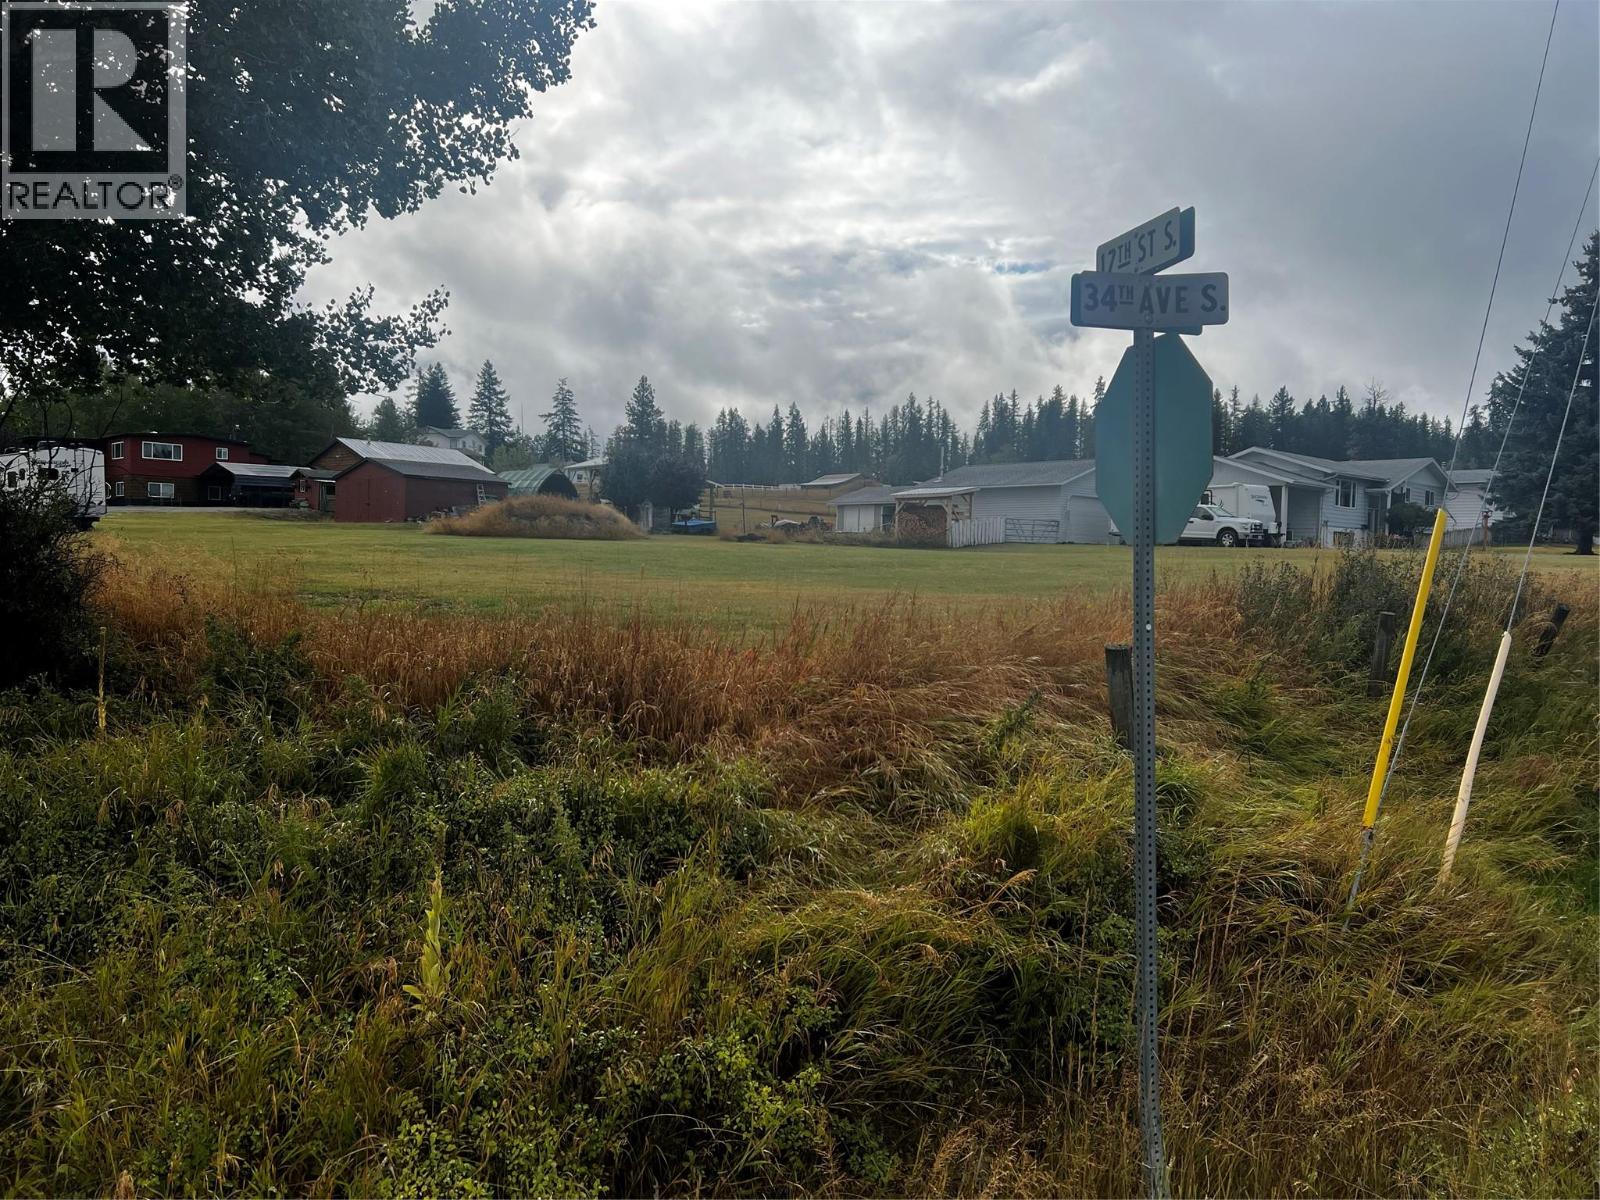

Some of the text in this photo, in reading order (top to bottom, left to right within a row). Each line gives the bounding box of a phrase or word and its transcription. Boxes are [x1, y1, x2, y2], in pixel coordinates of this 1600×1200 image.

[1101, 220, 1177, 273] 17TH ST S.
[1084, 283, 1226, 314] 34TH AVE S.
